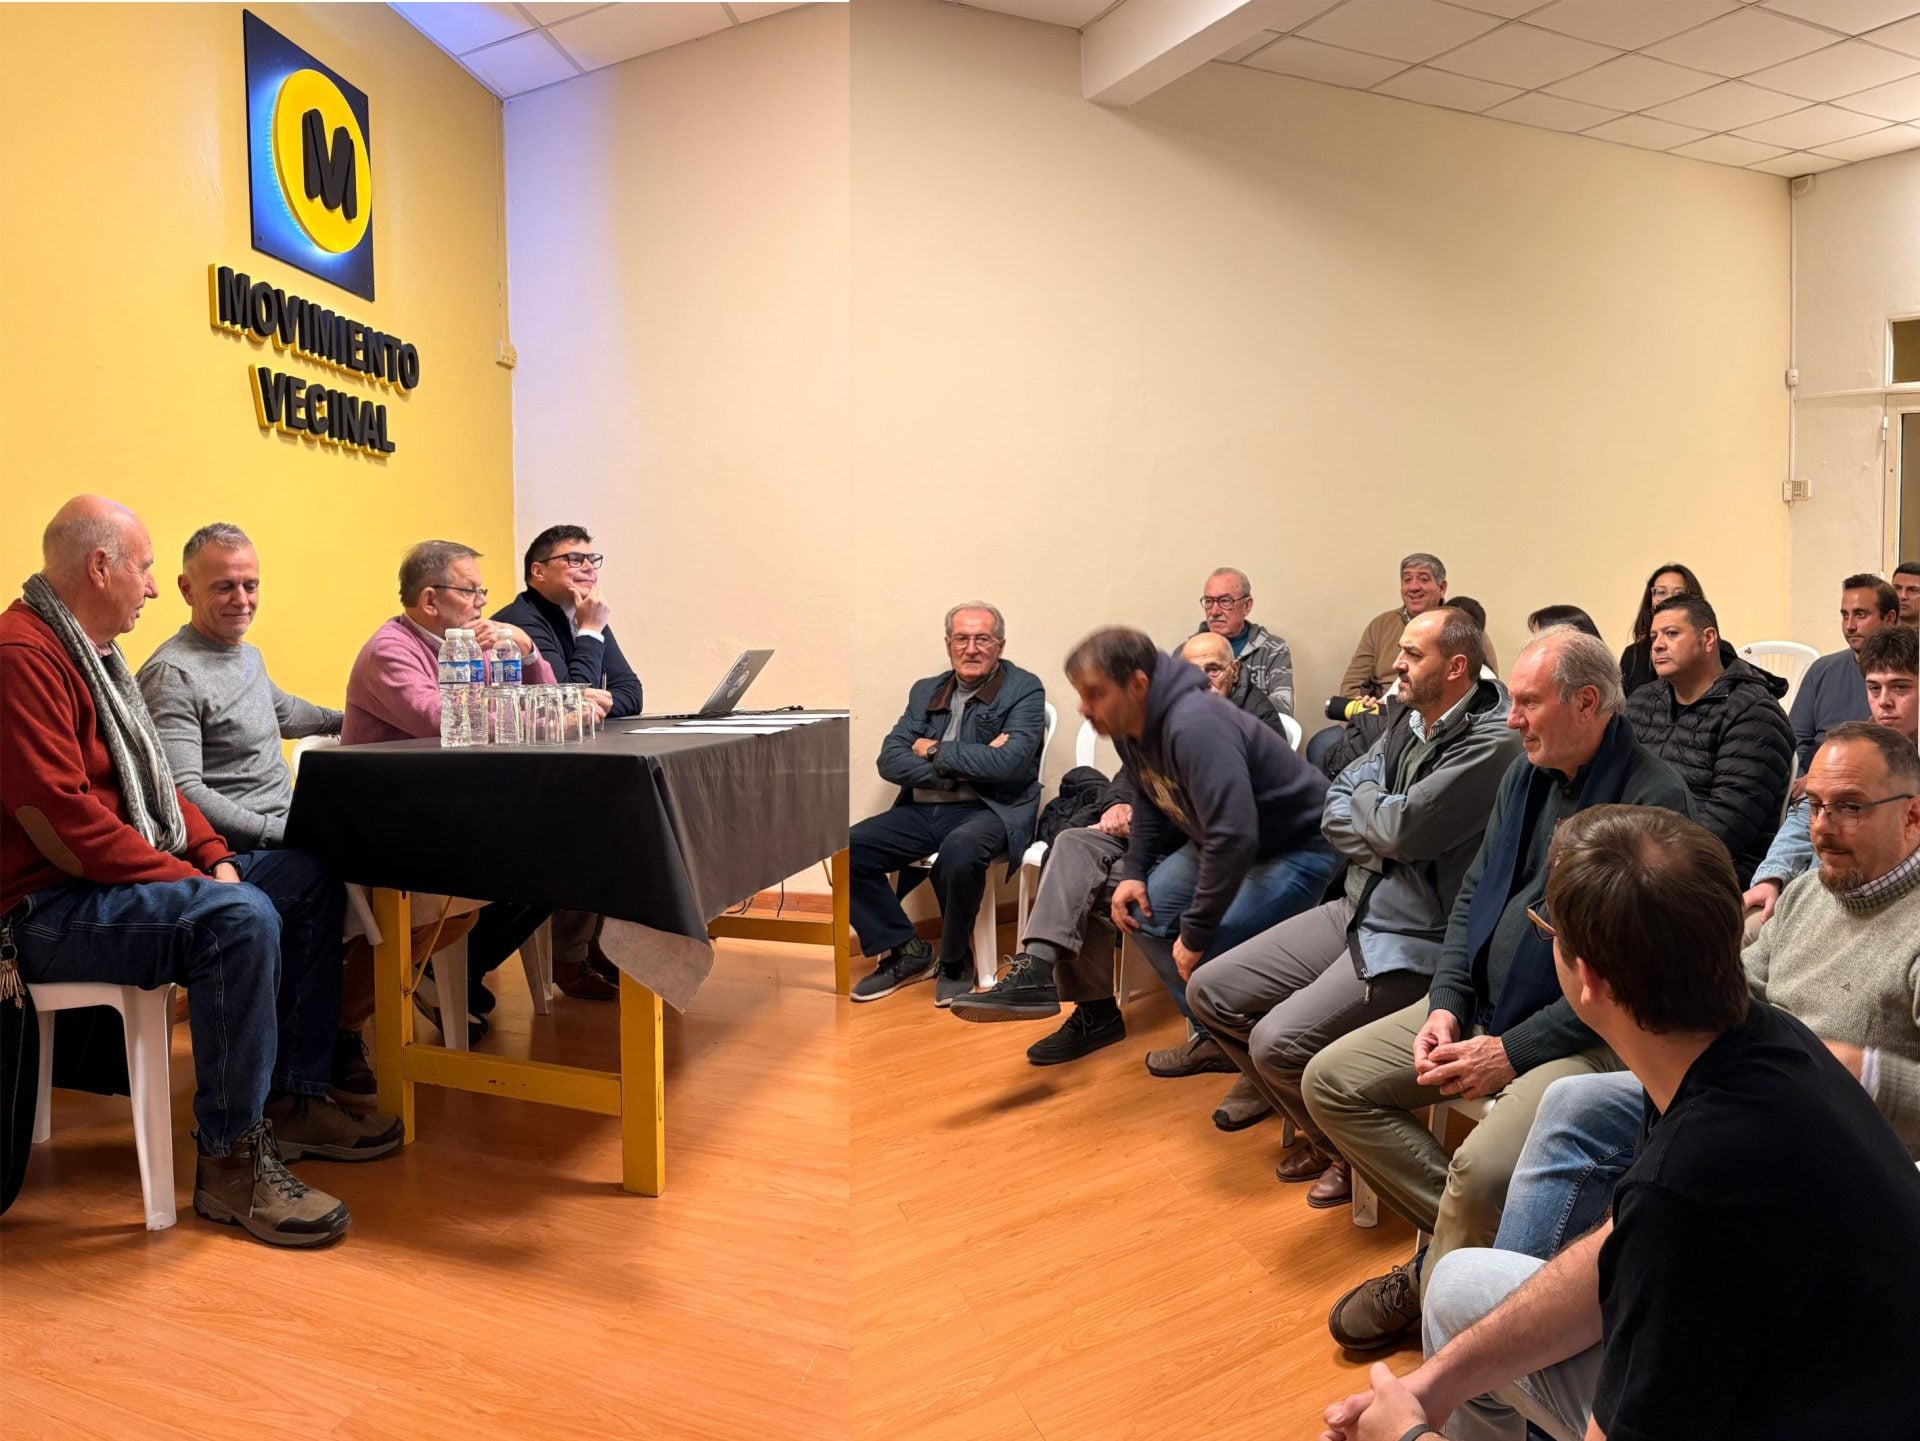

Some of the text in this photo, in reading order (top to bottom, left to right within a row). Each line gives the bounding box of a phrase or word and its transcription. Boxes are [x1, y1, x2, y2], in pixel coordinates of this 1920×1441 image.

[302, 108, 358, 221] M
[215, 264, 420, 391] MOVIMIENTO
[256, 365, 396, 454] VECINAL
